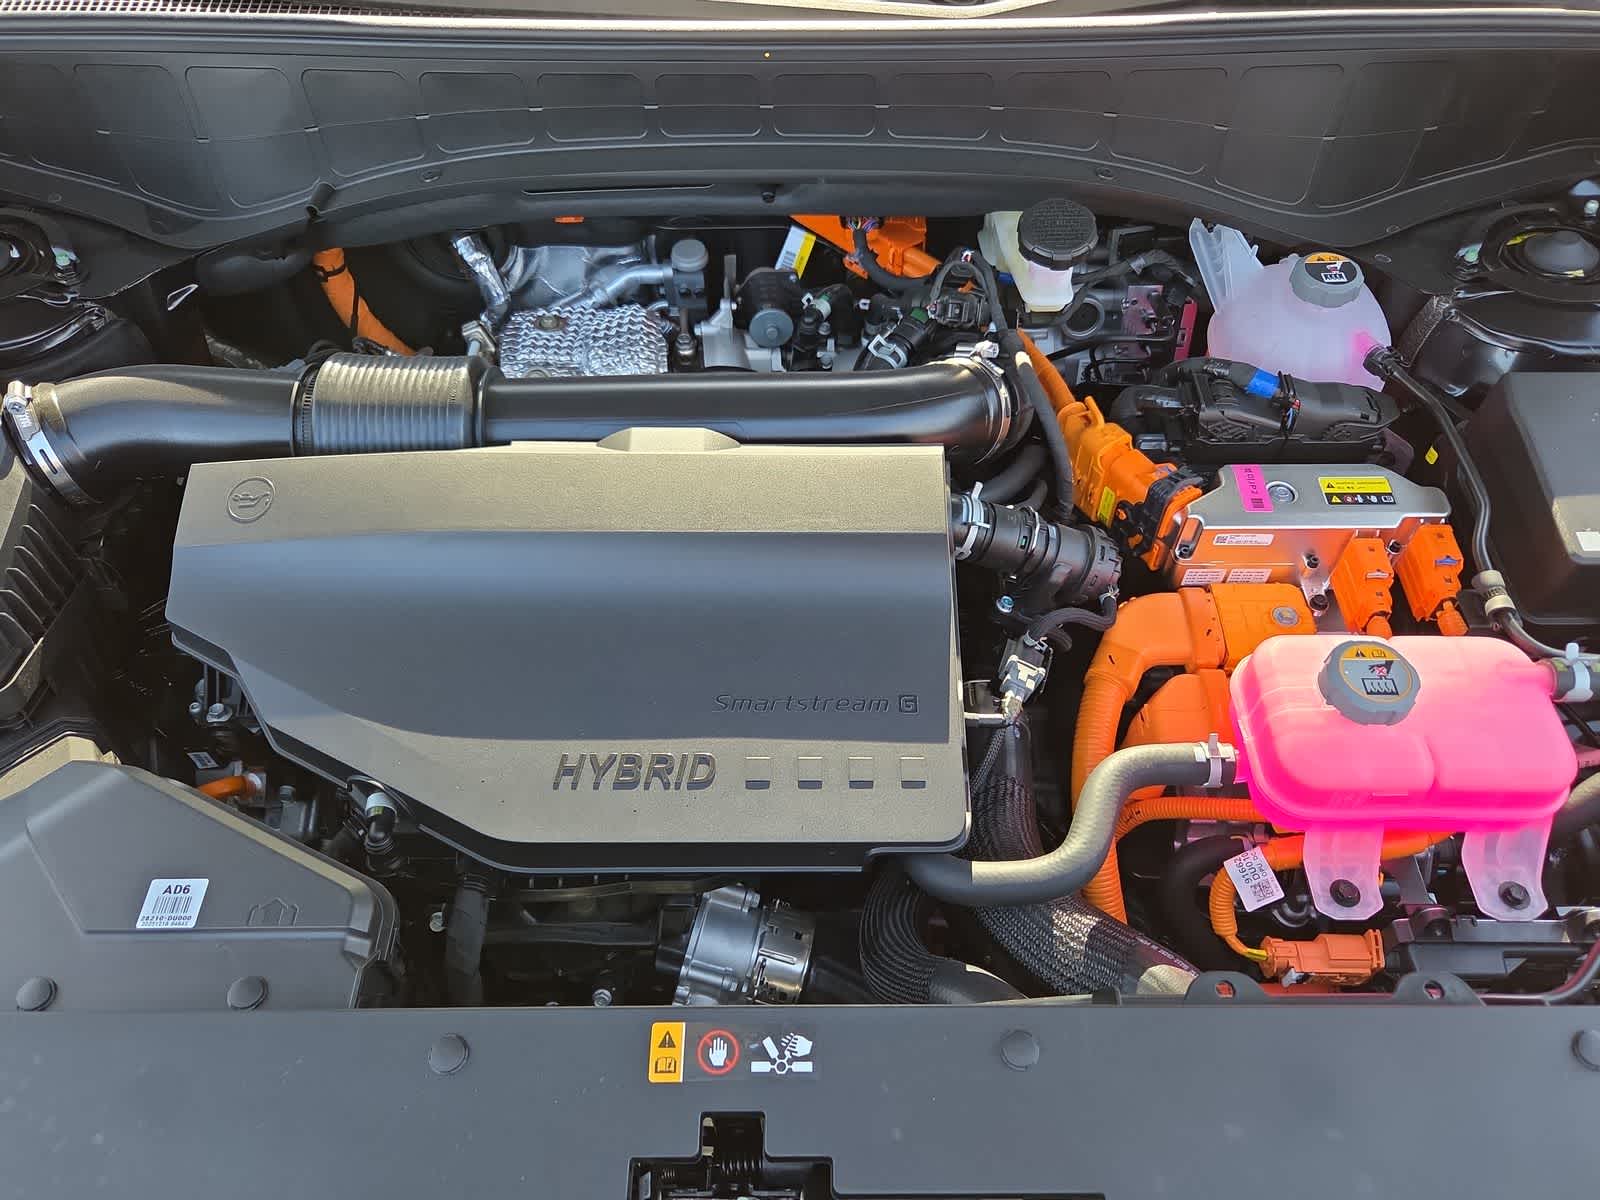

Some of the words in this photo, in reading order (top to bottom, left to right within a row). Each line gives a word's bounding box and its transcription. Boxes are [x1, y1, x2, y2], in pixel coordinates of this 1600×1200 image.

[714, 694, 890, 713] Smartstream
[552, 752, 718, 791] HYBRID
[1234, 857, 1253, 885] 91662
[162, 884, 192, 895] AD6
